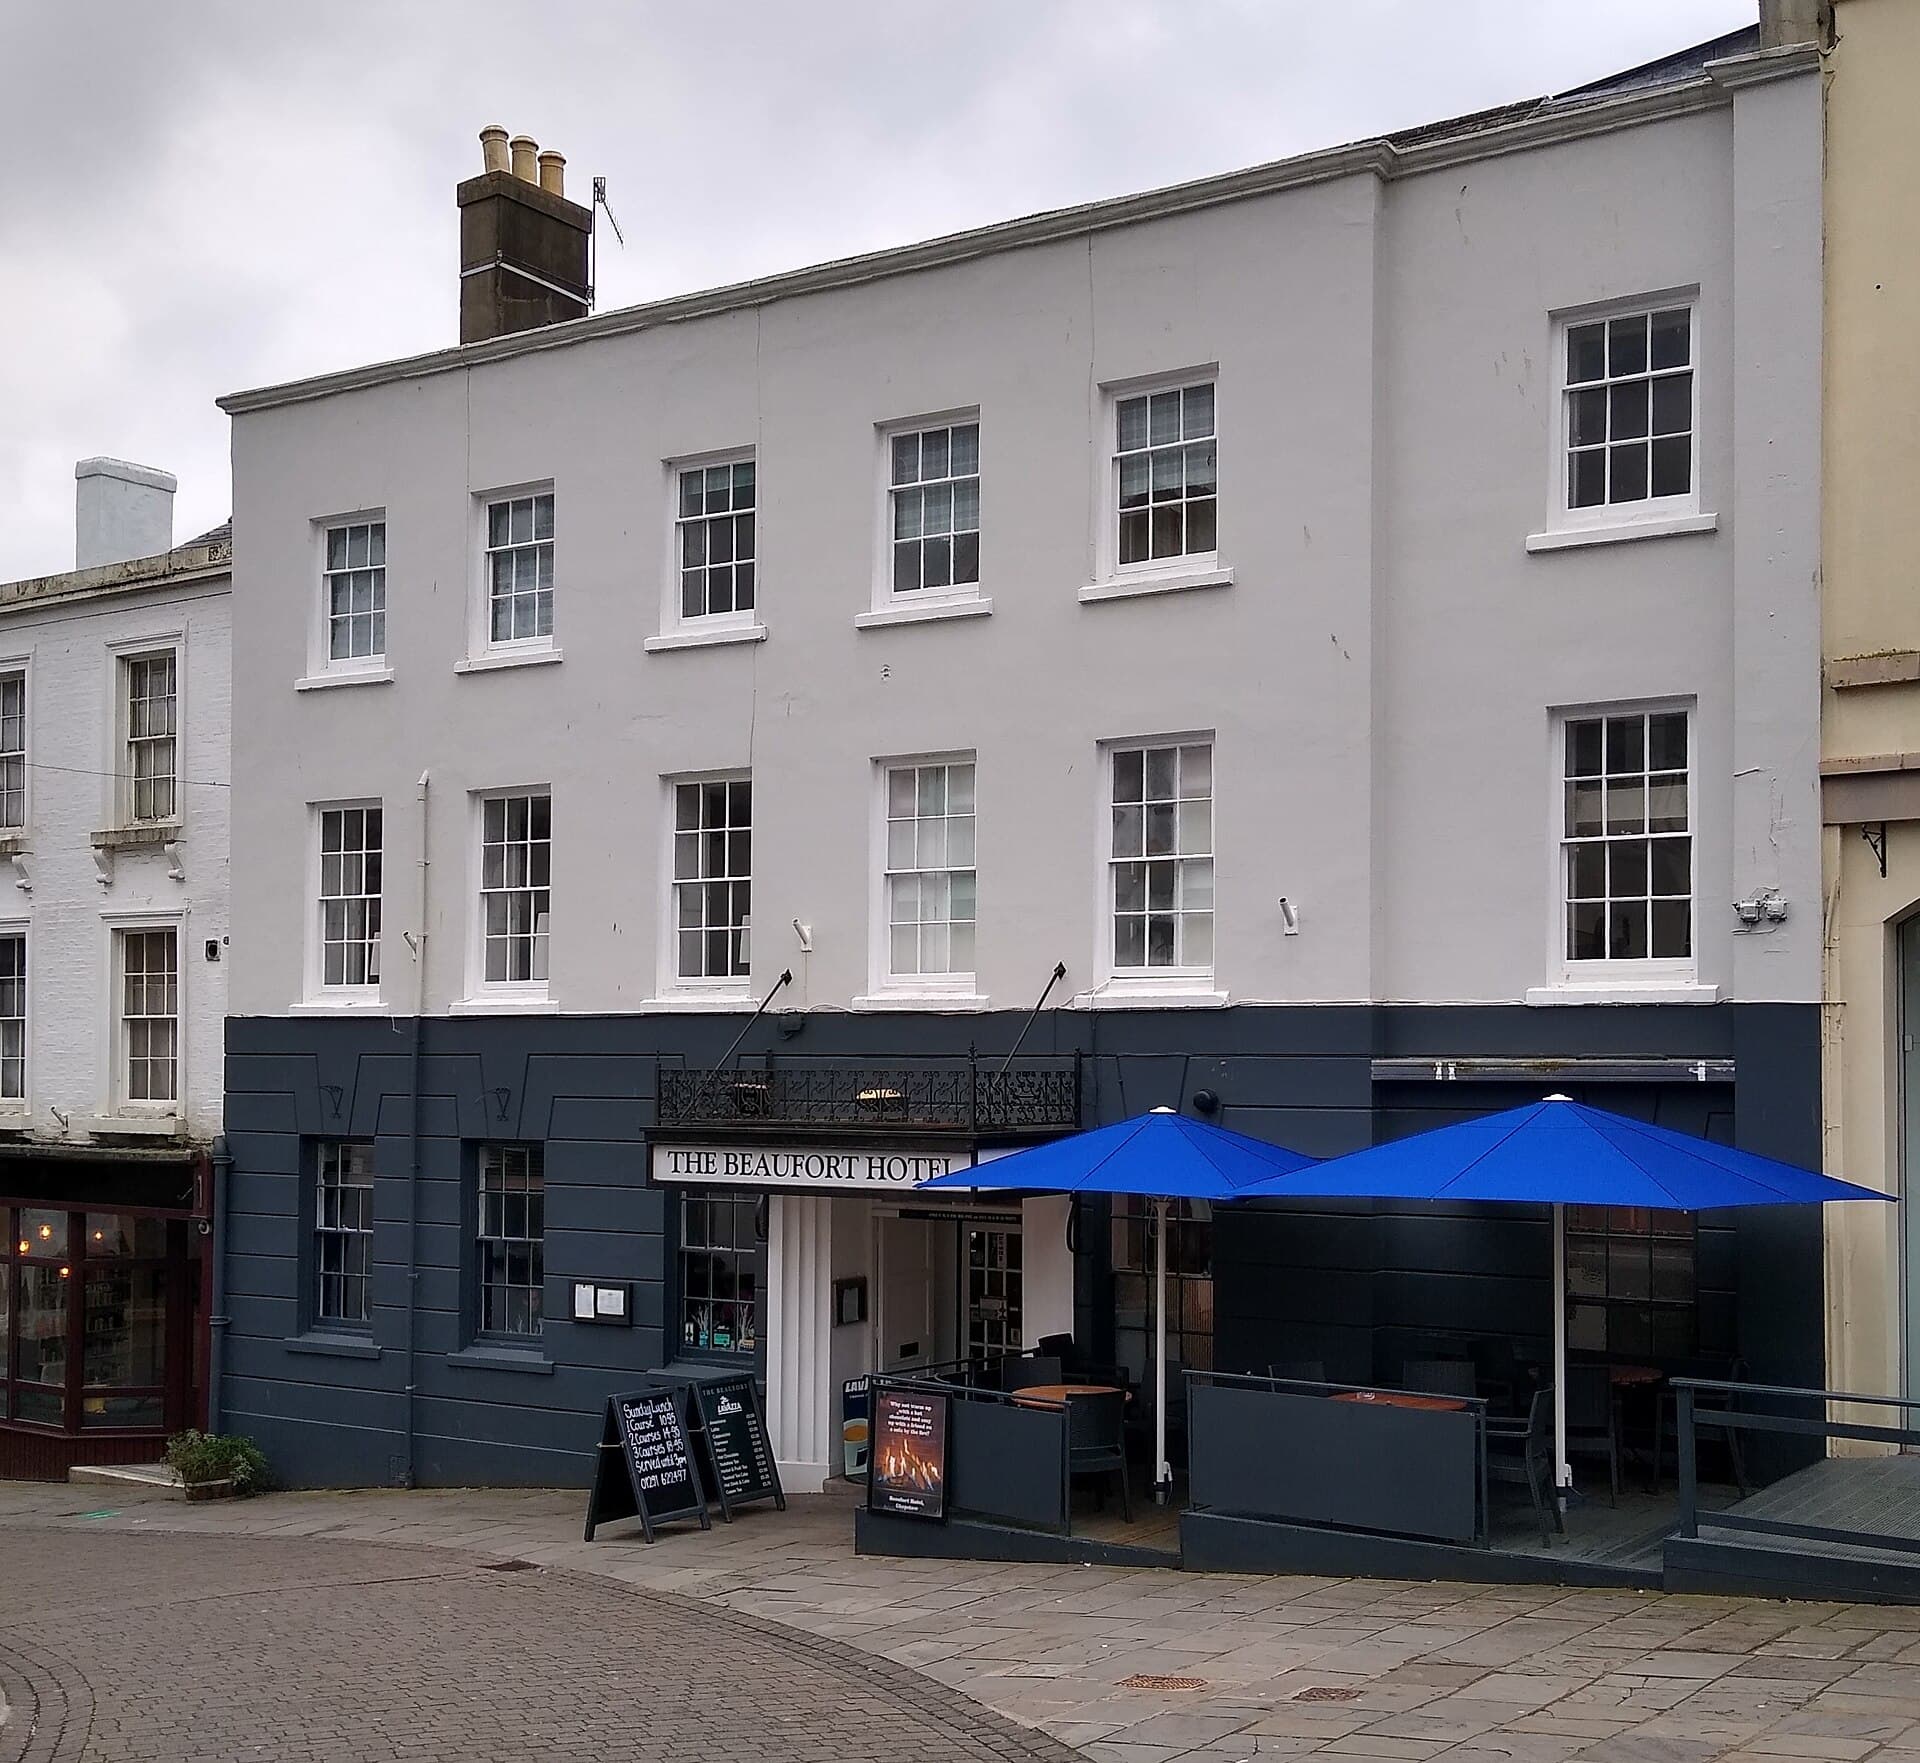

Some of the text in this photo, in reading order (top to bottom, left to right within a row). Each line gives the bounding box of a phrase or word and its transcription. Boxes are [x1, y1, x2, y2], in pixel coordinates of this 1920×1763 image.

[667, 1150, 717, 1175] THE
[723, 1152, 860, 1181] BEAUFORT
[623, 1396, 674, 1419] Sunday Lunch
